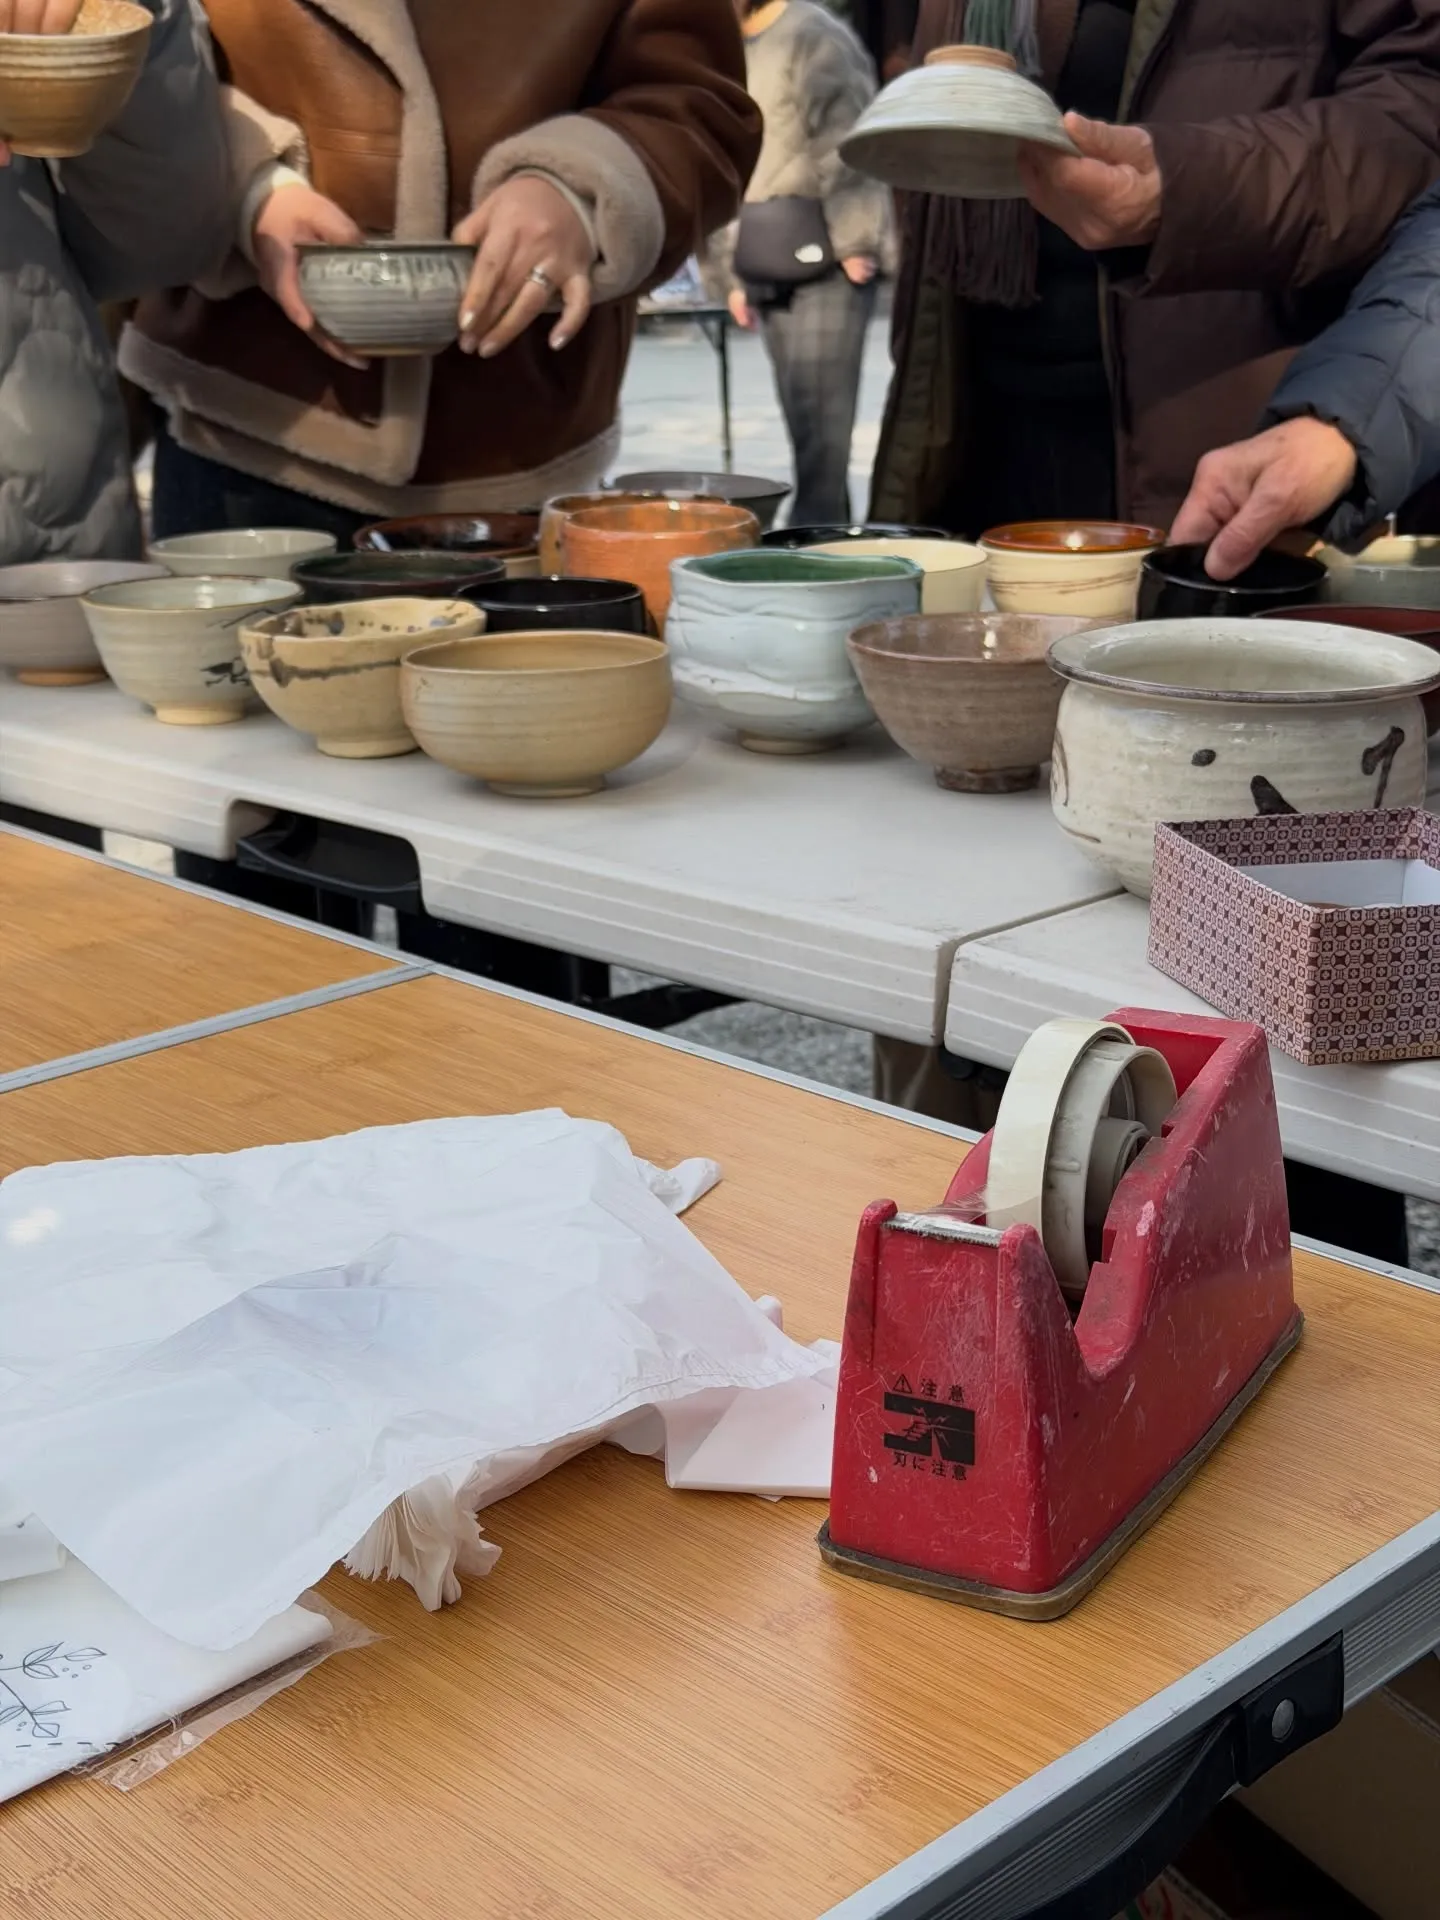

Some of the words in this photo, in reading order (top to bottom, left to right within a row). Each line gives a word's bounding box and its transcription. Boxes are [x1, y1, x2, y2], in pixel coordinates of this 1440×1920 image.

[920, 1379, 964, 1402] 注意
[893, 1452, 967, 1480] 刃に注意
